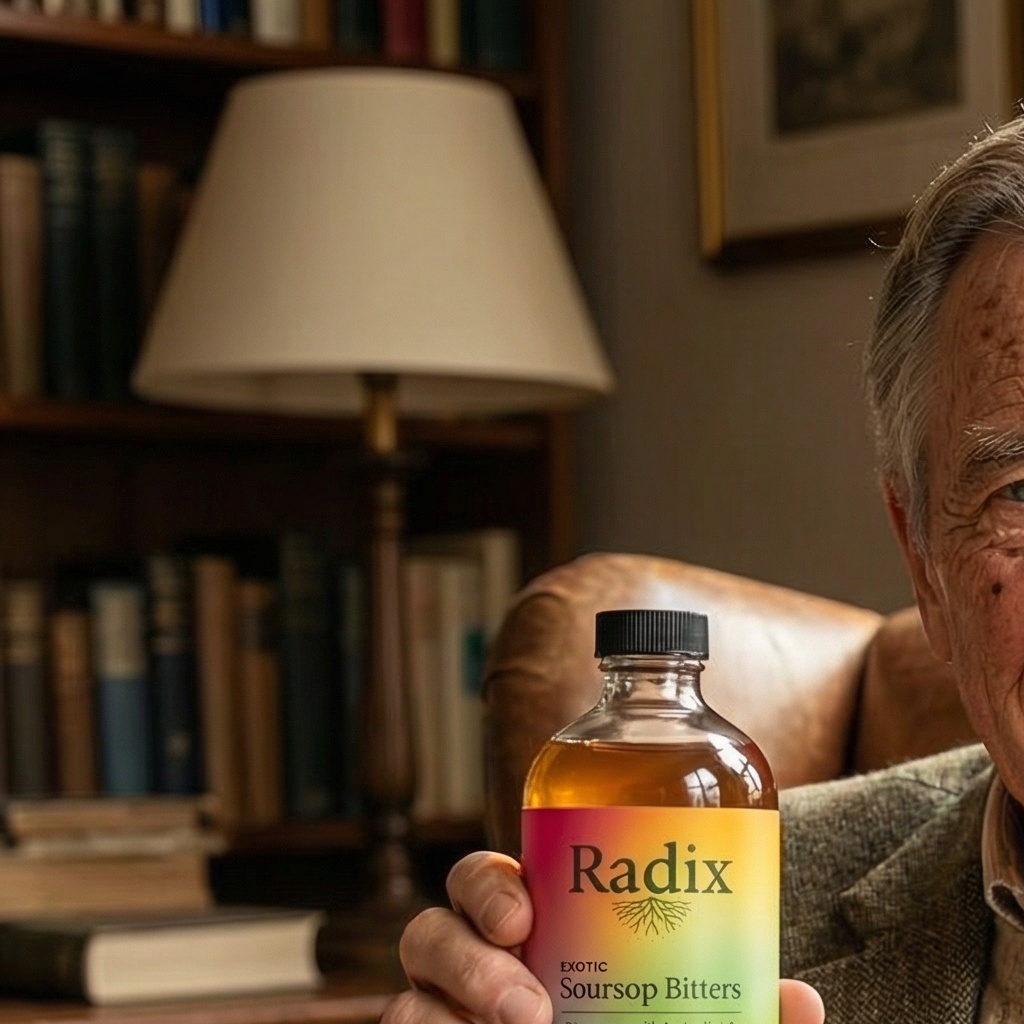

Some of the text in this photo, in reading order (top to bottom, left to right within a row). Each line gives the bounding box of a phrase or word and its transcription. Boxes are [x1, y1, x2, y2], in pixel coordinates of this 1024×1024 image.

[568, 841, 733, 895] Radix
[560, 961, 608, 973] EXOTIC
[560, 976, 742, 1007] Soursop Bitters
